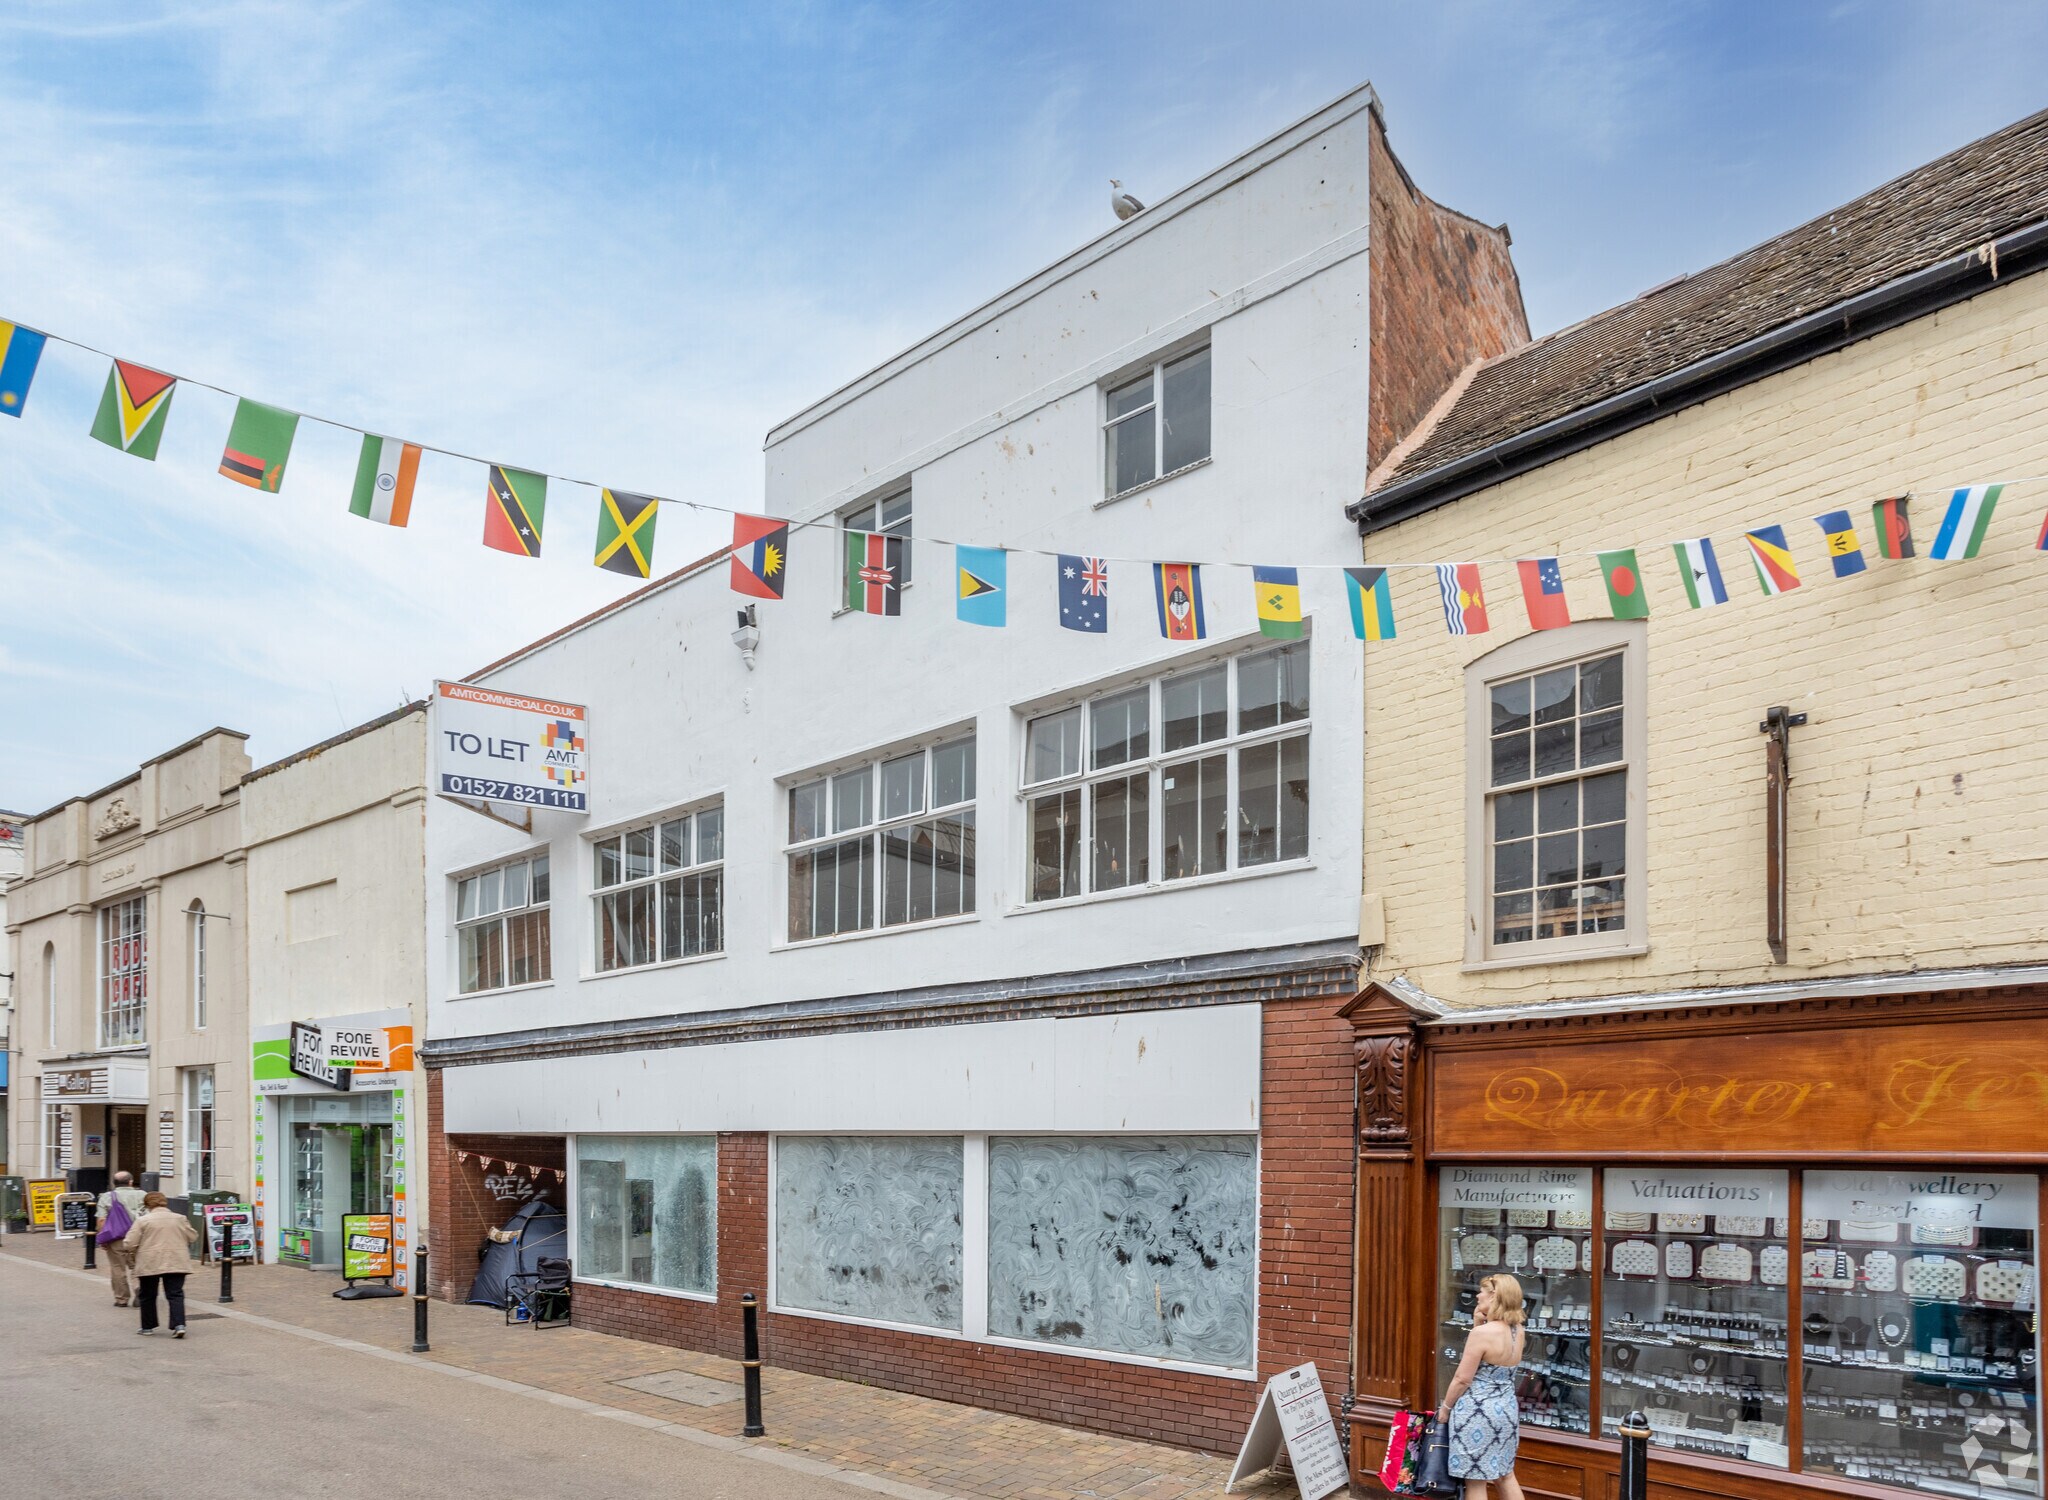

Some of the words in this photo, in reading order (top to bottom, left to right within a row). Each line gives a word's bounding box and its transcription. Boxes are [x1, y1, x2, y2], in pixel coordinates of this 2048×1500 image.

[449, 687, 577, 717] AMTCOMMERCIAL.CO.UK
[444, 731, 482, 755] TO
[488, 737, 530, 762] LET
[544, 760, 580, 770] COMMERCIAL
[546, 749, 578, 764] AMT
[450, 776, 509, 799] 01527
[512, 785, 545, 803] 821
[551, 790, 580, 809] 111
[336, 1031, 373, 1045] FONE
[330, 1045, 380, 1058] REVIVE
[1484, 1060, 1833, 1134] Quarter
[1453, 1168, 1530, 1184] Diamond
[1538, 1169, 1578, 1188] Ring
[1832, 1174, 1874, 1192] Old
[1879, 1175, 2004, 1201] Jewellery
[1453, 1187, 1576, 1206] Manufacturers
[1630, 1178, 1760, 1202] Valuations
[1850, 1199, 1982, 1222] Purchased
[354, 1243, 383, 1252] REVIVE
[360, 1236, 380, 1245] FONE
[1277, 1386, 1298, 1402] Quarter
